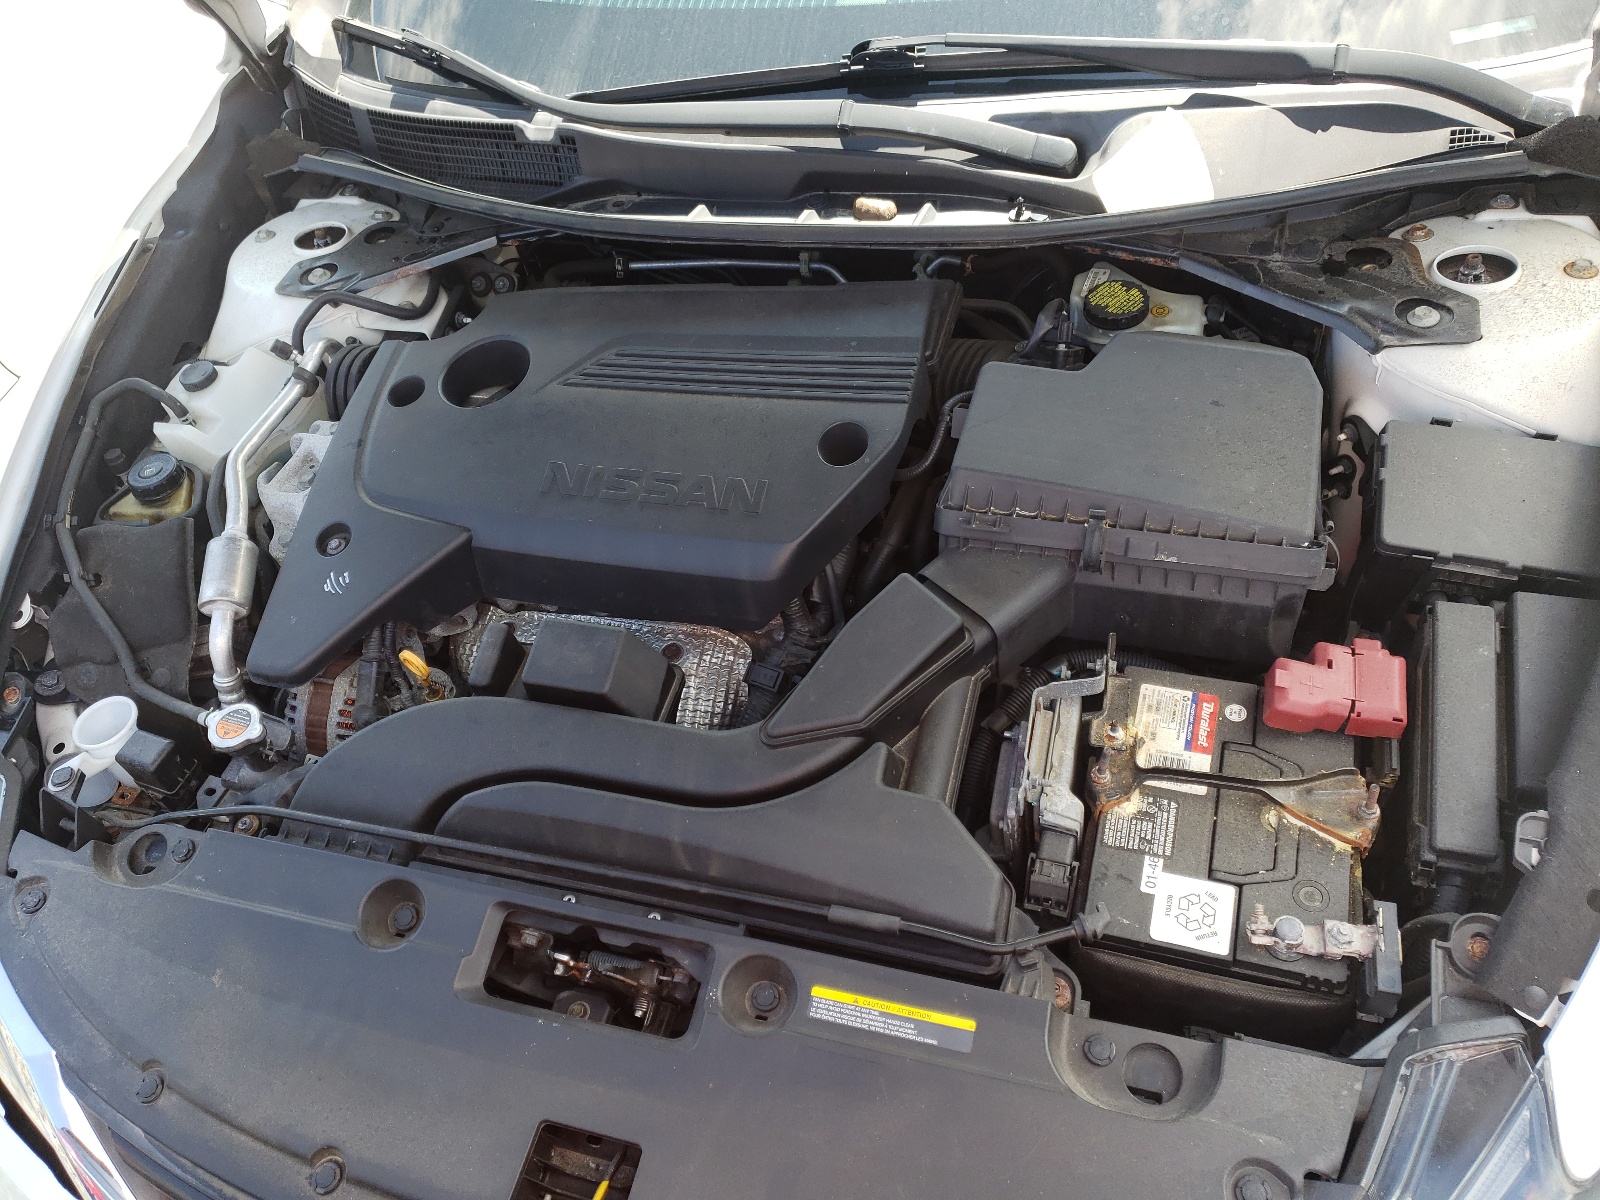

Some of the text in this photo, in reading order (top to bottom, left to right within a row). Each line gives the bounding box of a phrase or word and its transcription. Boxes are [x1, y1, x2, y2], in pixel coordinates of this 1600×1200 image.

[539, 461, 769, 514] NISSAN
[1197, 702, 1214, 747] Duralast
[1164, 894, 1174, 918] RECYCLE
[1204, 890, 1219, 903] LEAD
[1195, 930, 1218, 941] RETURN
[862, 1000, 890, 1010] CAUTION
[896, 1007, 931, 1019] ATTENTION
